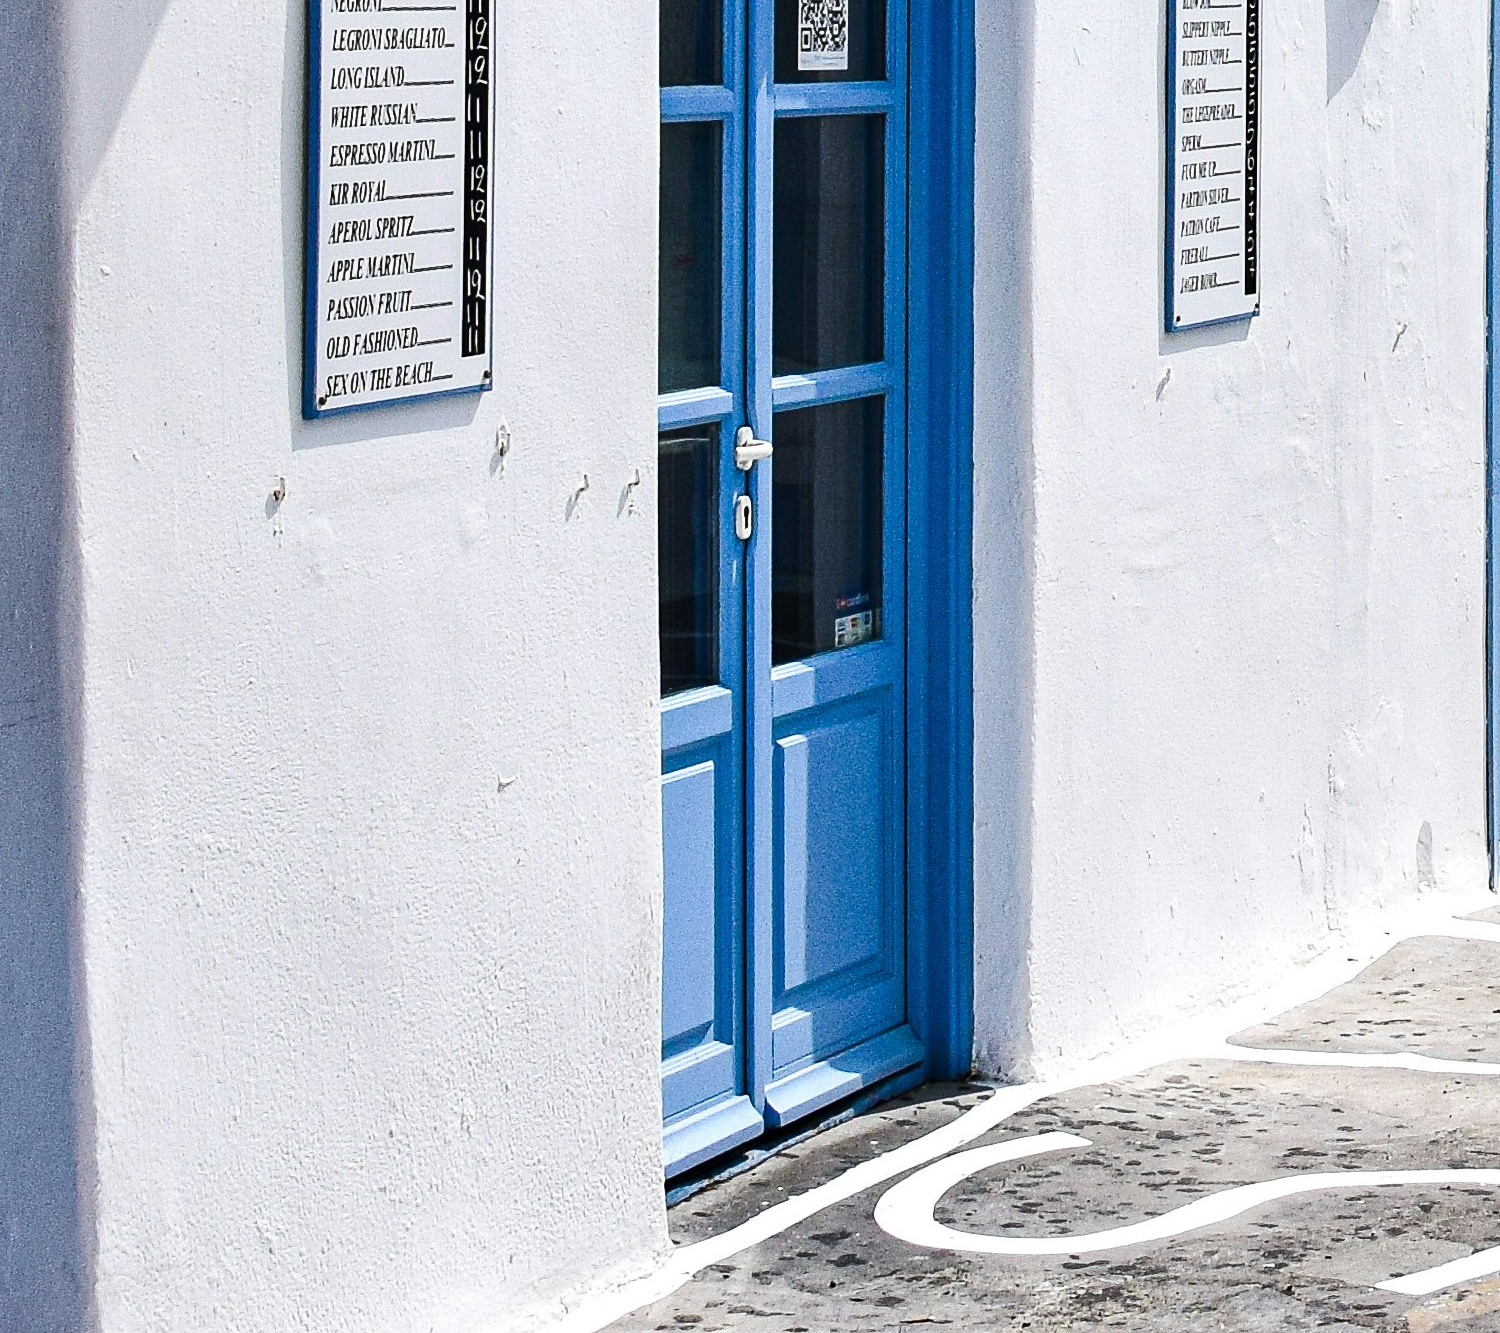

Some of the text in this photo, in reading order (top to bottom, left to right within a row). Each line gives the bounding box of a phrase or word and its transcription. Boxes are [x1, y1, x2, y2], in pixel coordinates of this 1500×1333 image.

[384, 27, 446, 50] SBAGLIATO
[331, 67, 362, 90] LONG
[364, 66, 405, 89] ISLAND
[331, 105, 368, 128] WHITE
[369, 103, 418, 126] RUSSIAN
[329, 142, 386, 167] ESPRESSO
[387, 139, 436, 163] MARTINI
[329, 183, 349, 205] KIR
[350, 180, 387, 203] ROYAL
[328, 218, 373, 244] APEROL
[375, 215, 414, 240] SPRITZ
[327, 256, 365, 283] APPLE
[366, 253, 415, 278] MARTINI
[327, 294, 376, 321] PASSION
[377, 290, 413, 315] FRUIT
[326, 335, 351, 359] OLD
[353, 327, 419, 355] FASHIONED
[326, 374, 349, 398] SEX
[350, 370, 368, 393] ON
[370, 367, 394, 391] THE
[395, 361, 434, 387] BEACH
